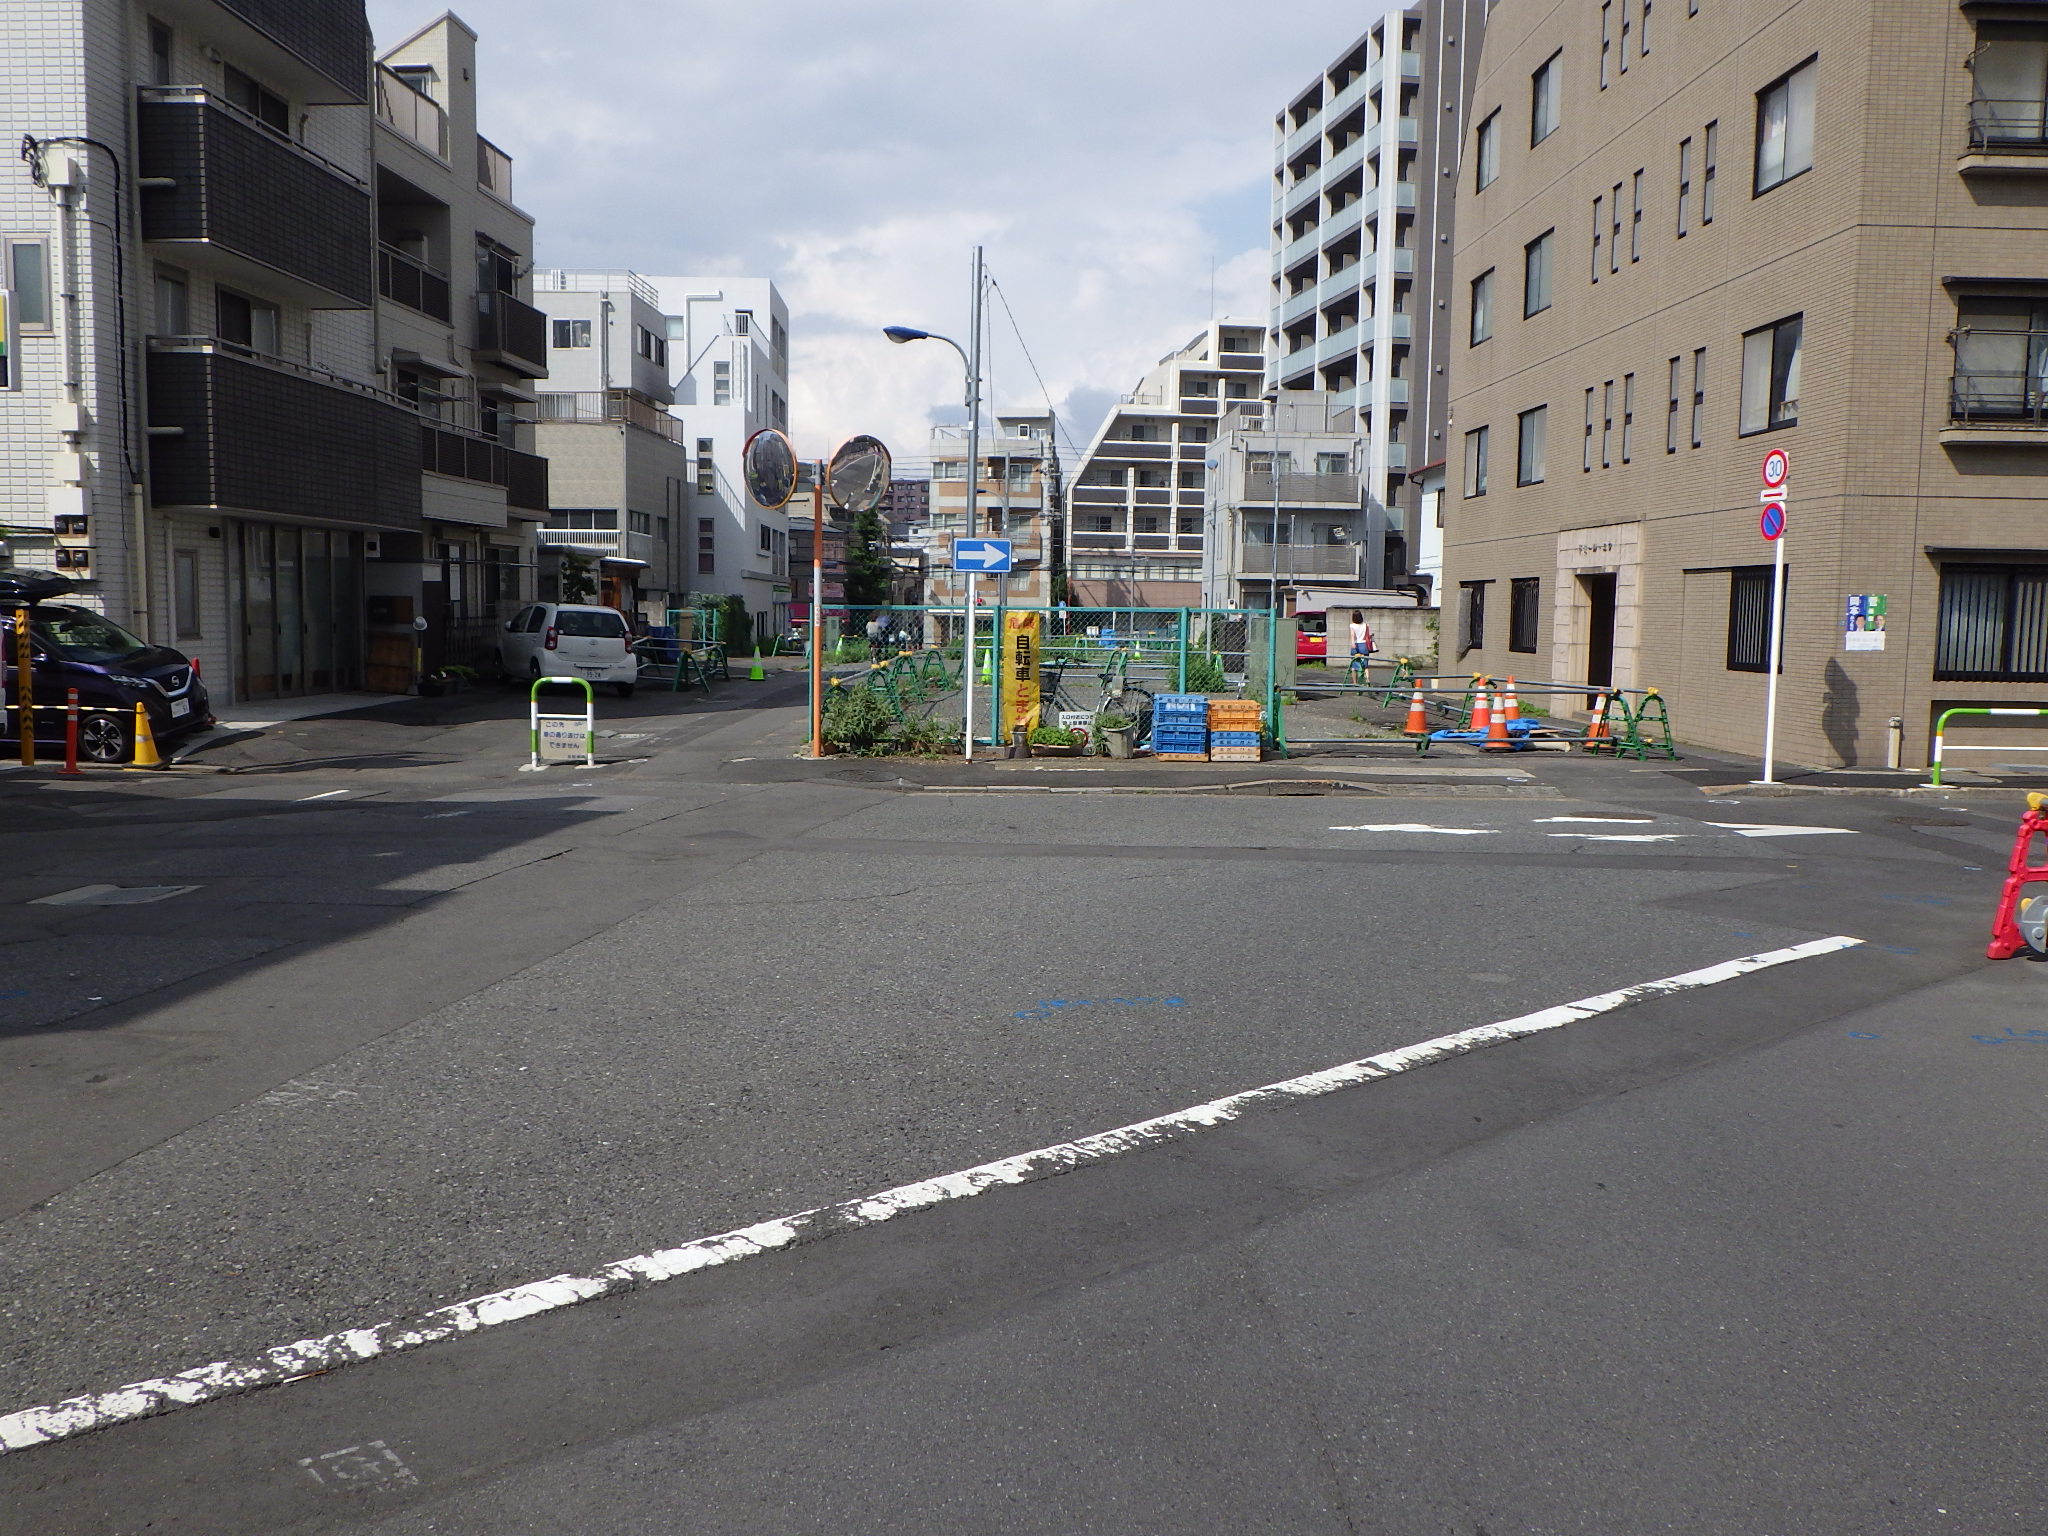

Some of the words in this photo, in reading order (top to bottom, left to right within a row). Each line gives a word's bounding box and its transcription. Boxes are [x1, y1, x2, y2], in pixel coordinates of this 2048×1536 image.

[1768, 460, 1782, 477] 30
[549, 741, 580, 749] できません
